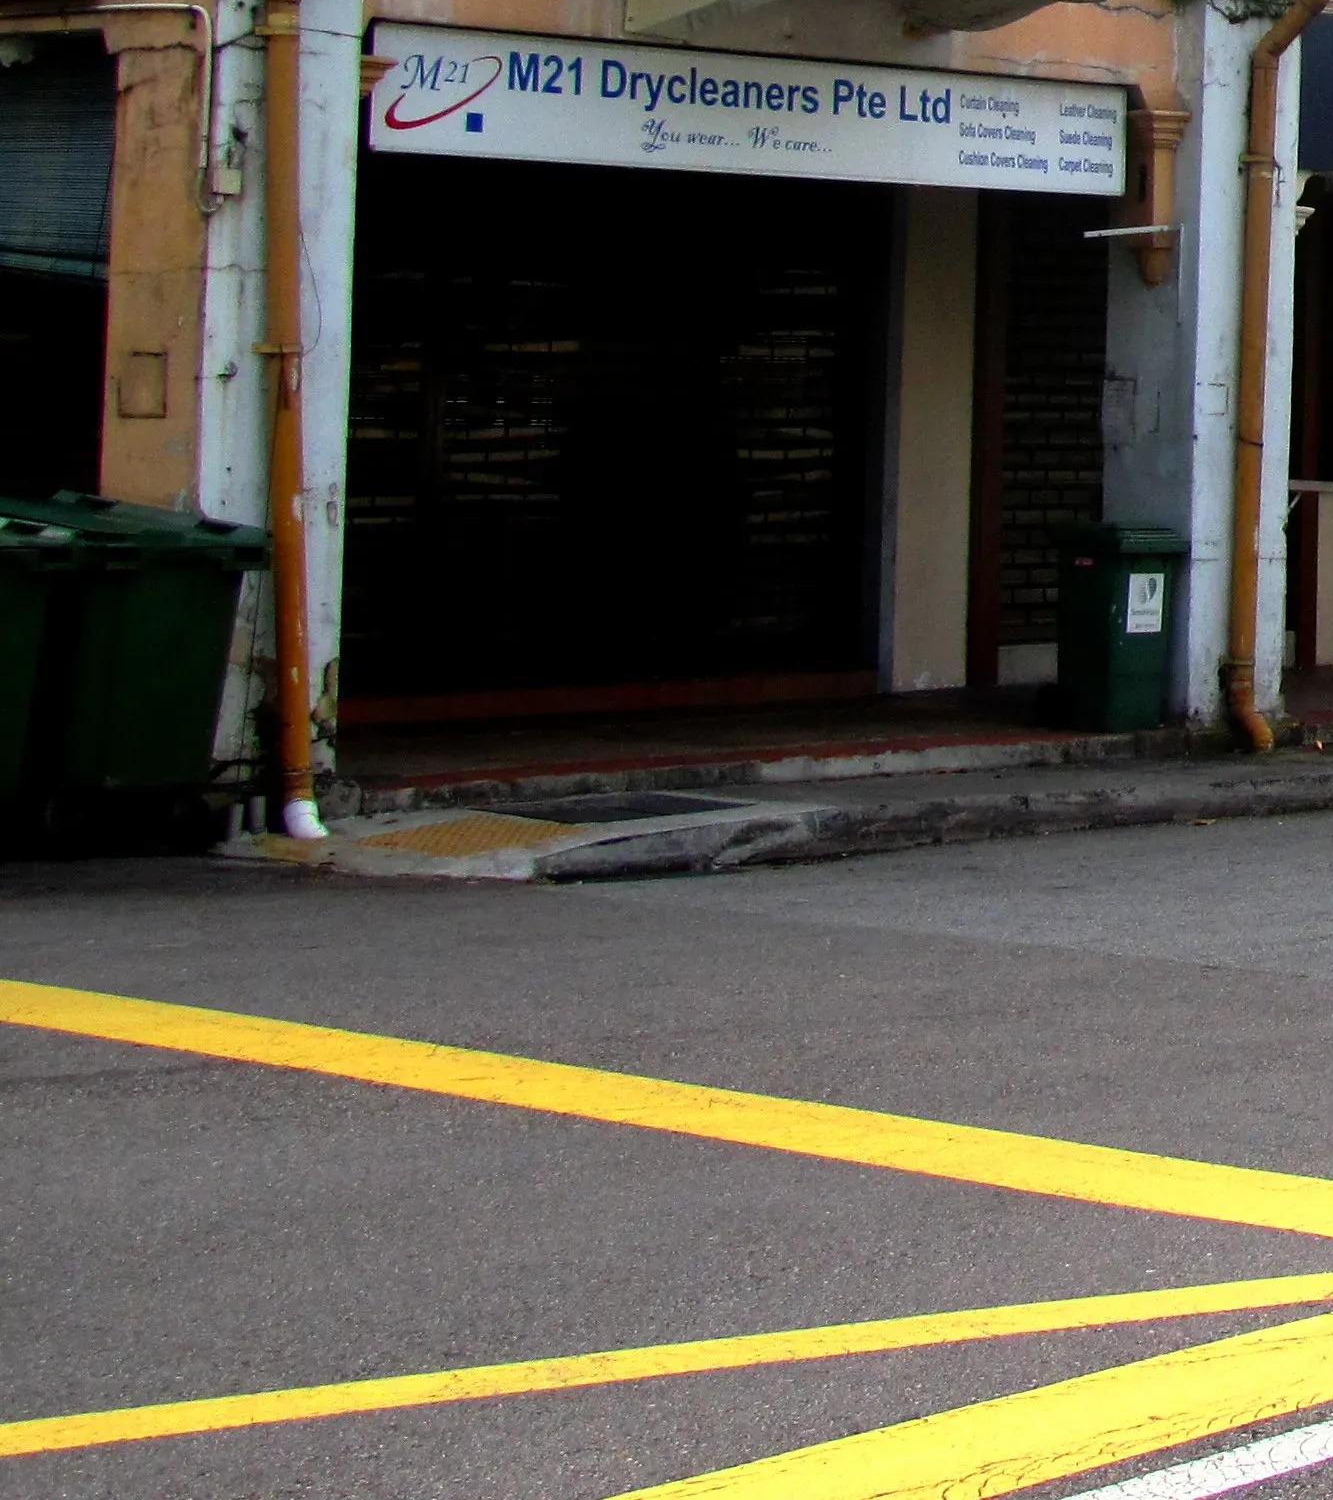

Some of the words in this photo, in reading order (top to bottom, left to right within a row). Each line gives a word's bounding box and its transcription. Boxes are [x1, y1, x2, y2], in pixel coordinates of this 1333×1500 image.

[508, 51, 583, 96] M21
[600, 59, 820, 112] Drycleaners
[833, 78, 888, 120] Pte
[899, 85, 951, 125] Ltd
[960, 94, 987, 111] Curtain
[988, 97, 1020, 117] Cleaning
[1060, 103, 1087, 119] Leather
[1087, 104, 1118, 125] Cleaning
[641, 118, 682, 153] You
[959, 122, 977, 138] Sofa
[977, 124, 1003, 140] Covers
[1004, 126, 1037, 146] Cleaning
[1059, 129, 1082, 146] Suede
[1082, 131, 1113, 151] Cleaning
[959, 150, 989, 167] Cushion
[990, 152, 1017, 169] Covers
[1017, 154, 1049, 174] Cleaning
[1058, 157, 1082, 176] Carpet
[1083, 158, 1114, 178] Cleaning
